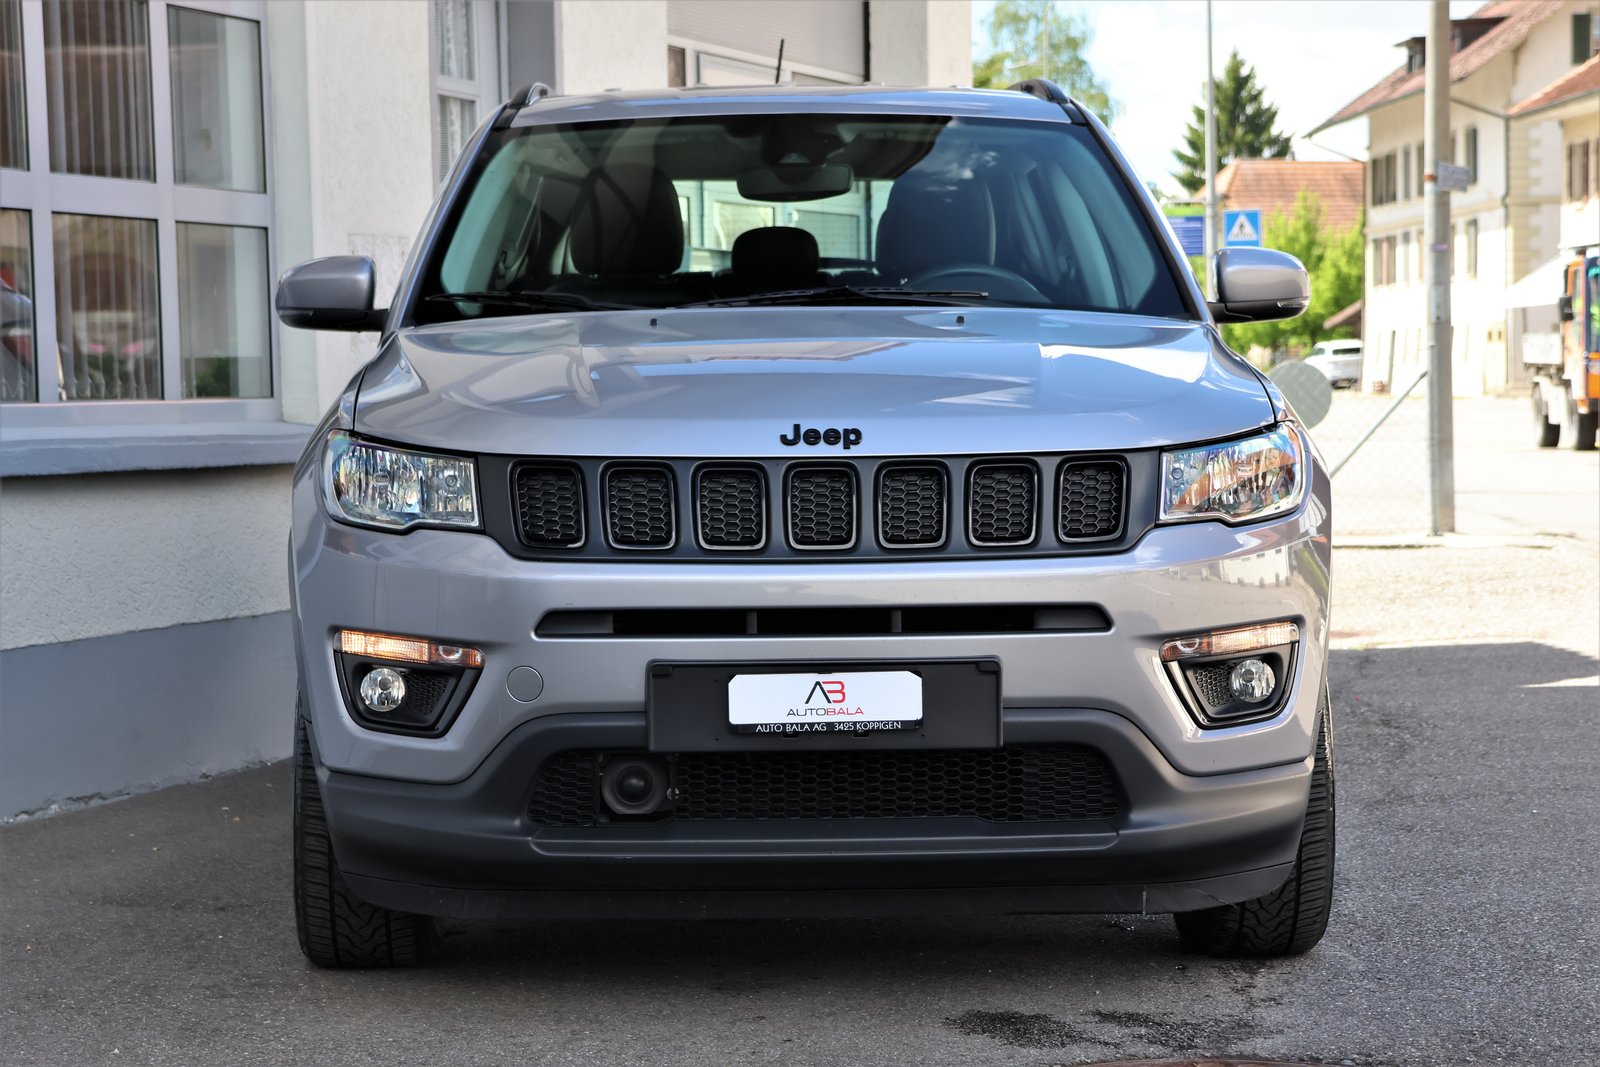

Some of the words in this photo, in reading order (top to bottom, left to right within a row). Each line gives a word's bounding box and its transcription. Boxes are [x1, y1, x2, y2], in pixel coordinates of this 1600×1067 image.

[780, 424, 862, 449] Jeep
[787, 707, 864, 717] AUTOBALA
[756, 724, 783, 733] AUTO
[786, 723, 811, 732] BALA
[812, 723, 827, 732] AG
[834, 722, 854, 731] 3425
[856, 721, 901, 731] KOPPIGEN
